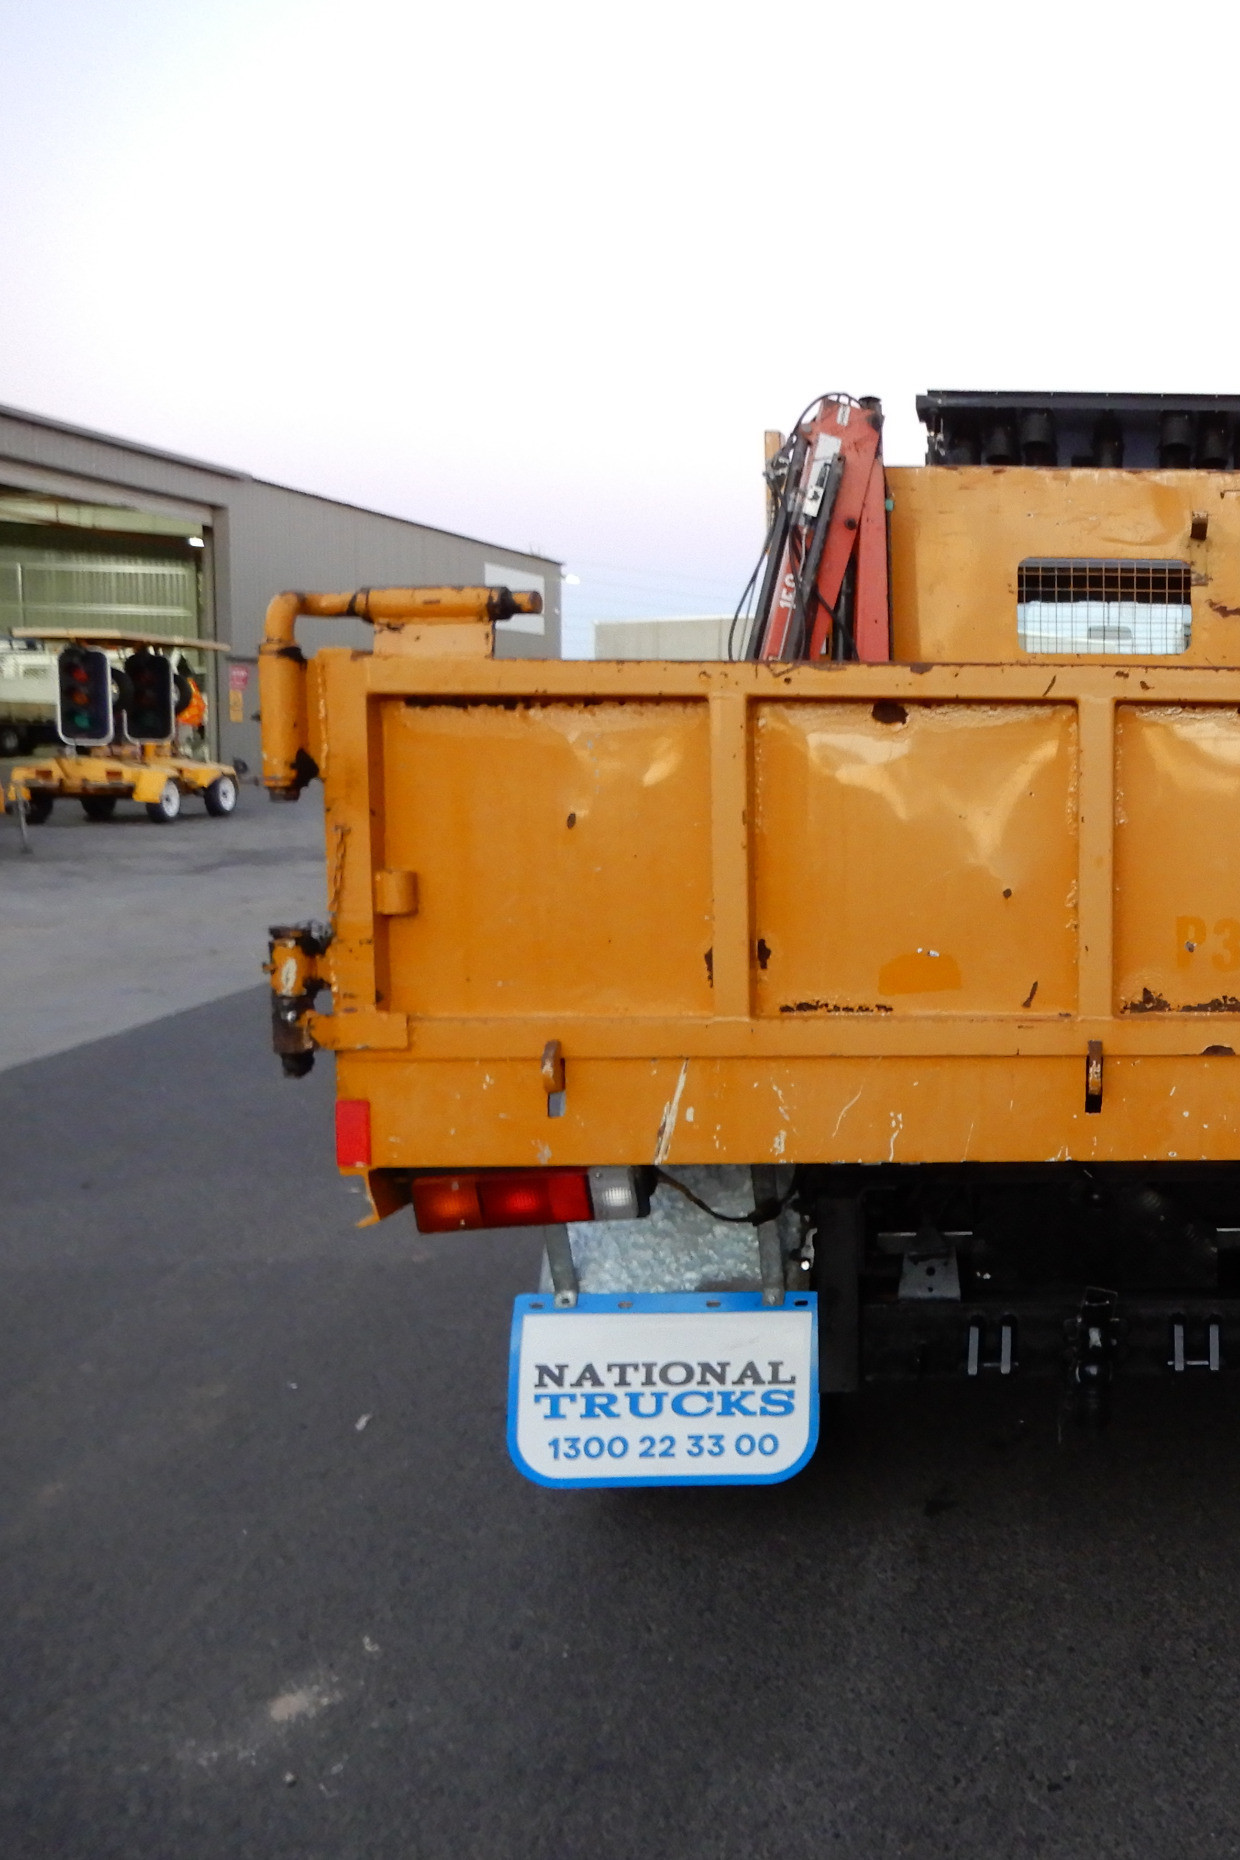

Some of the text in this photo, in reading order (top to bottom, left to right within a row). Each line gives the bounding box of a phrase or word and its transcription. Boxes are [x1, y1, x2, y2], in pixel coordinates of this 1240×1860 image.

[533, 1360, 797, 1388] NATIONAL
[533, 1388, 797, 1420] TRUCKS
[547, 1432, 781, 1461] 1300 22 33 00
